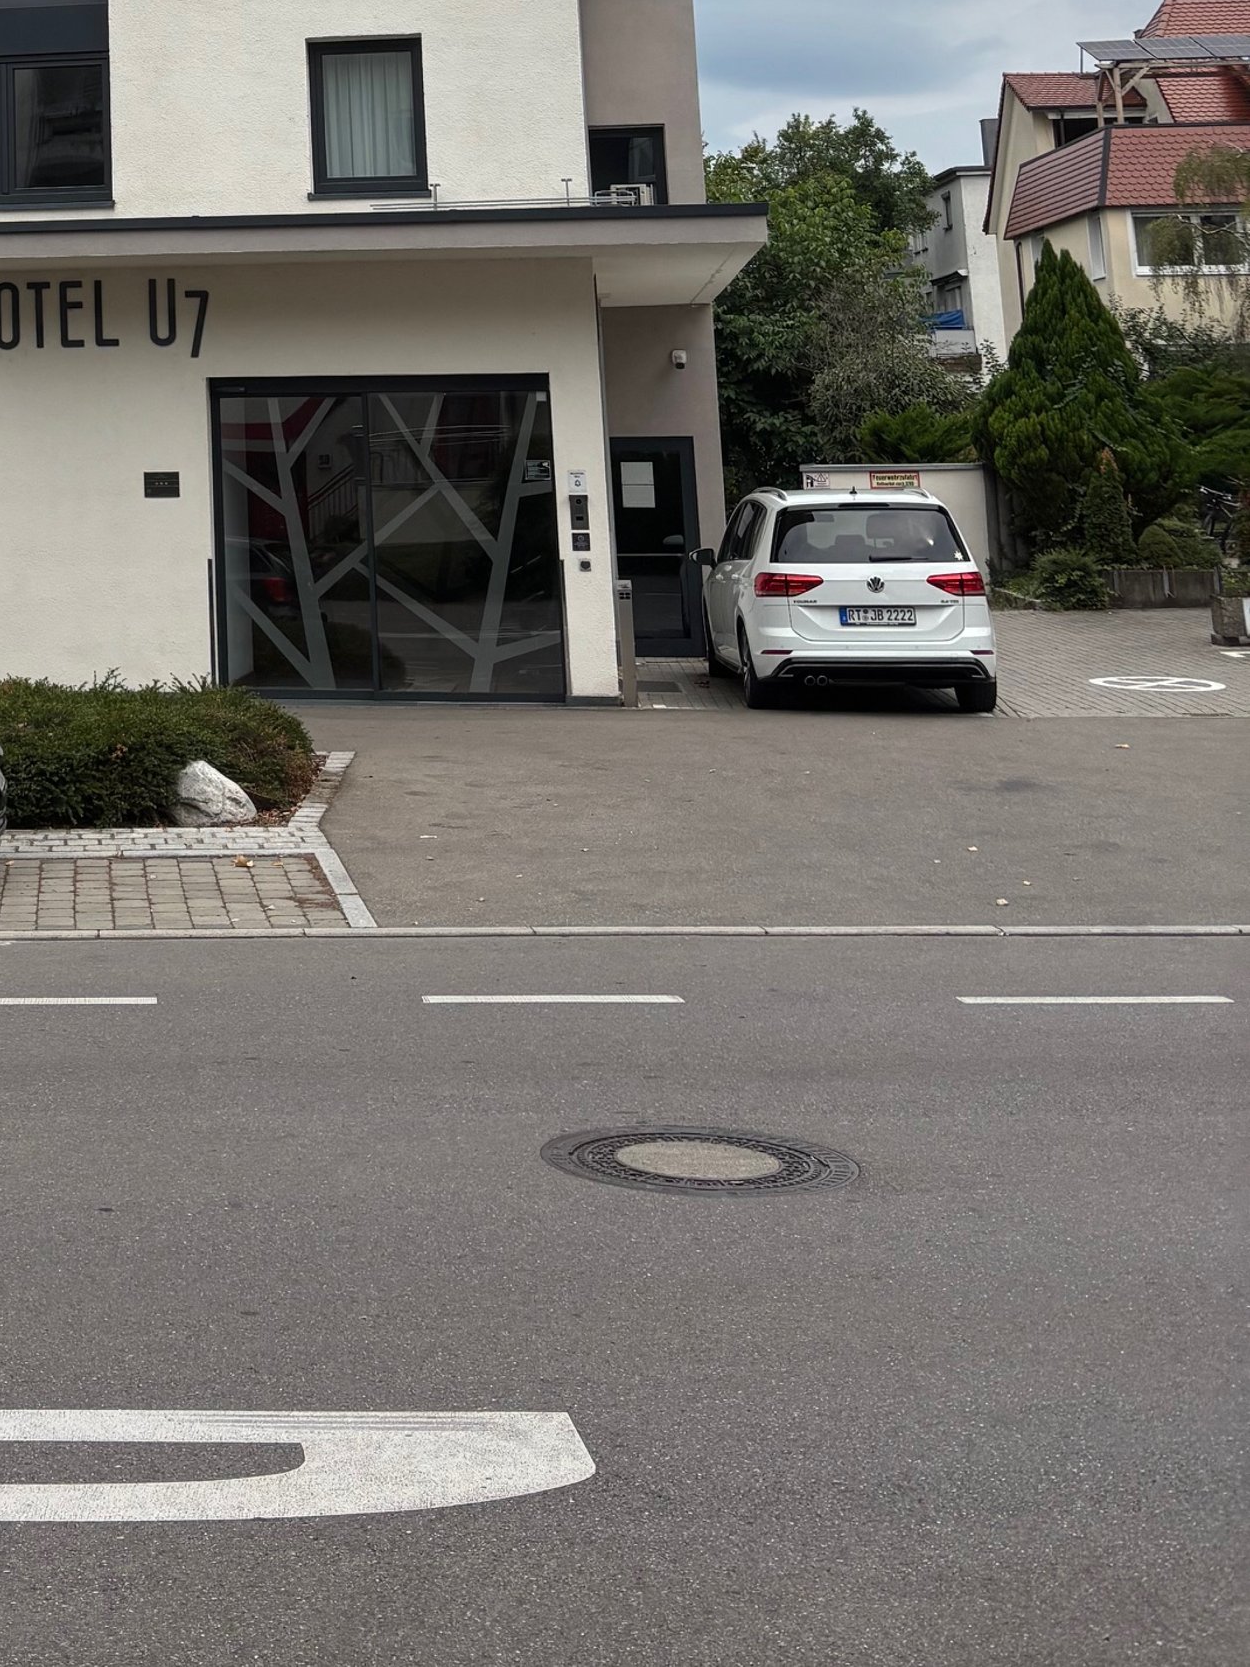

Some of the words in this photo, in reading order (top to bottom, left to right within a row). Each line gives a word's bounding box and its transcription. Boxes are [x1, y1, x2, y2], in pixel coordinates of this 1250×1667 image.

[148, 278, 210, 358] U7
[847, 609, 861, 621] RT
[870, 609, 884, 621] JB
[886, 609, 913, 621] 2222
